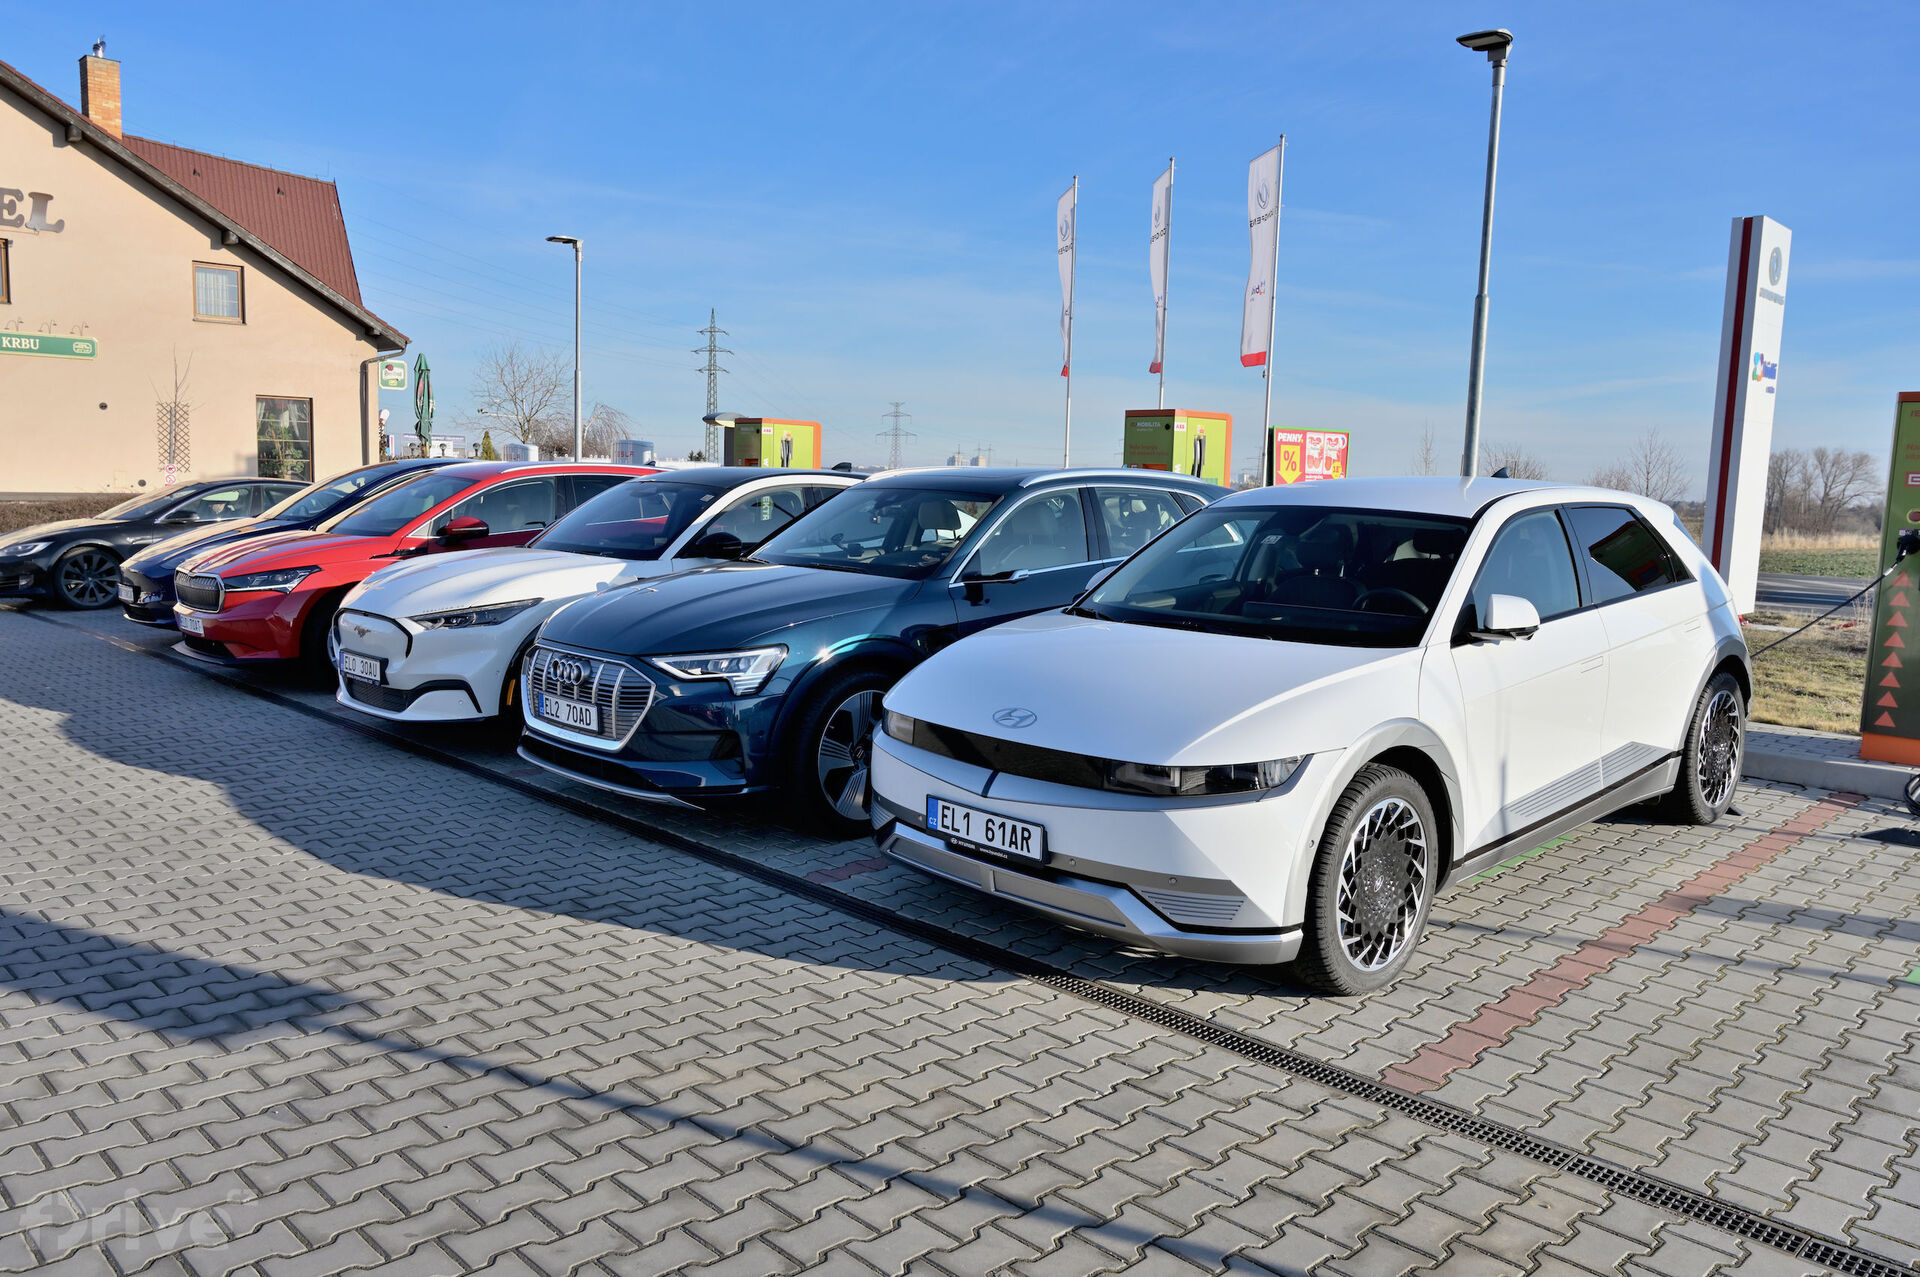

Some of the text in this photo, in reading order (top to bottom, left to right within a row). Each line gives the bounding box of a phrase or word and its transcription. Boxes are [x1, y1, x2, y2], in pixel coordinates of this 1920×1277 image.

[2, 336, 40, 350] KRBU
[361, 660, 377, 677] 30AU
[545, 697, 591, 726] EL2 70AD
[929, 817, 937, 825] CZ
[942, 805, 1031, 853] EL1 61AR
